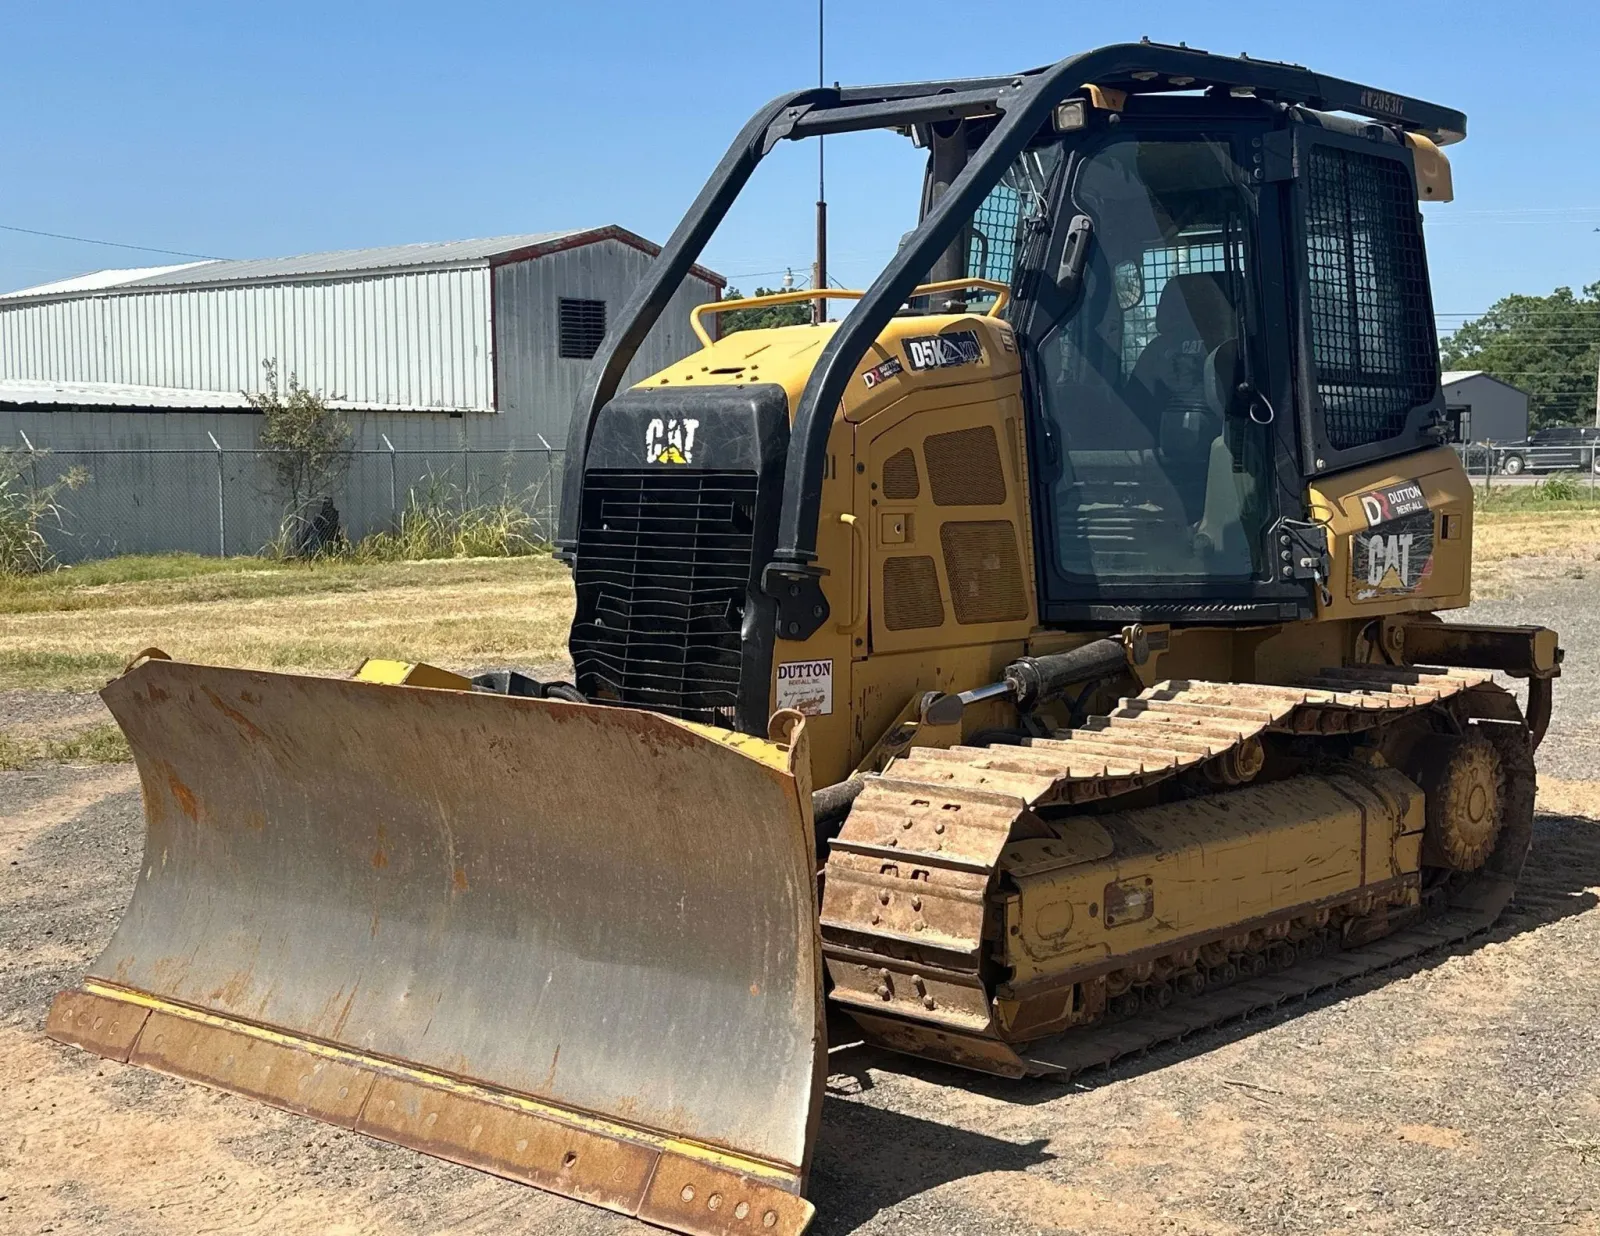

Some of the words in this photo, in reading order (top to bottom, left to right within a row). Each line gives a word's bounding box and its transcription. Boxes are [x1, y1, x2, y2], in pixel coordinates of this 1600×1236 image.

[646, 418, 699, 464] CAT
[1388, 485, 1422, 504] DUTTON
[1396, 500, 1423, 515] RENT-ALL
[1368, 533, 1413, 588] CAT
[778, 662, 831, 679] DUTTON
